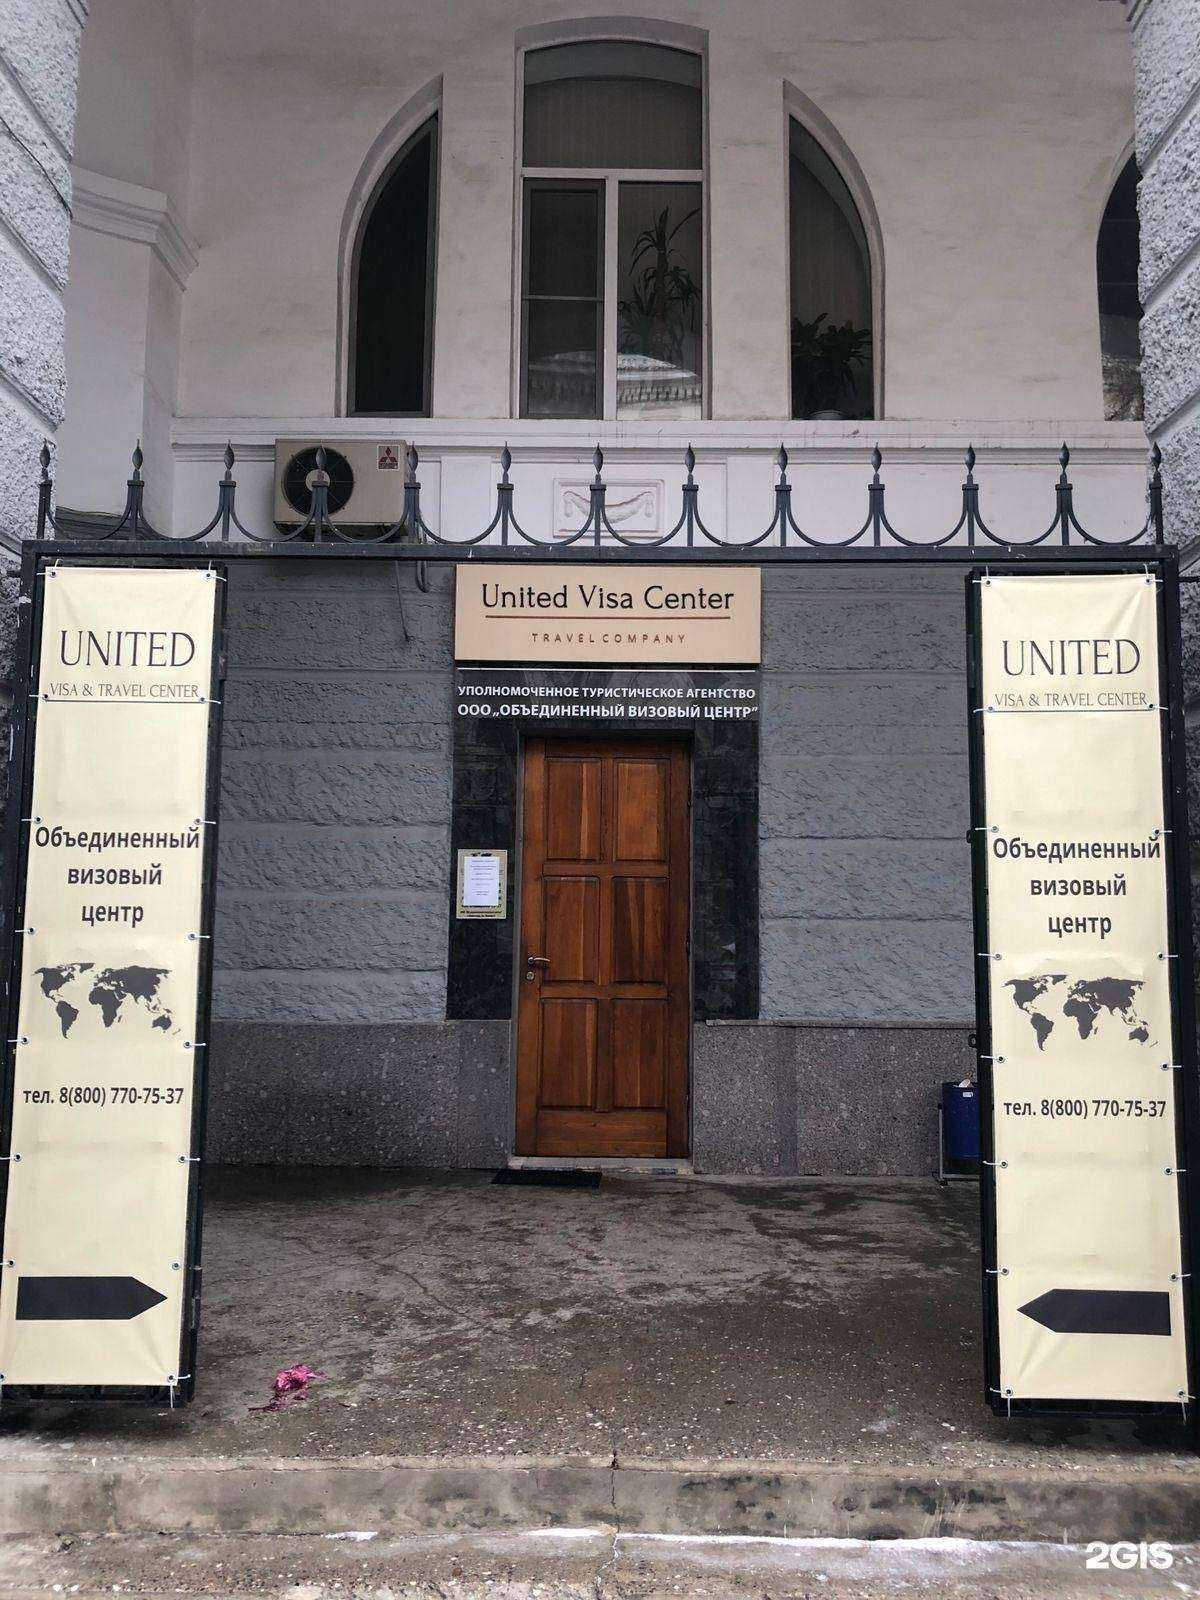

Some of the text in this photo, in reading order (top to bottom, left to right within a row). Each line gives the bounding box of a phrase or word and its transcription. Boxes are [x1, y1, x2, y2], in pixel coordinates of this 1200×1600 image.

[482, 583, 734, 610] United Visa Center
[59, 630, 196, 667] UNITED
[1002, 638, 1141, 676] UNITED
[49, 682, 199, 699] VISA & TRAVEL CENTER
[457, 685, 756, 699] УПОЛНОМОЧЕННОЕ ТУРИСТИЧЕСКОЕ АГЕНТСТВО
[994, 692, 1147, 707] VISA & TRAVEL CENTER
[628, 704, 700, 718] ВИЗОВЫЙ
[34, 825, 200, 853] Объединенный
[992, 836, 1161, 864] Объединенный
[67, 865, 162, 885] визовый
[1030, 873, 1127, 896] визовый
[81, 905, 144, 928] центр
[1048, 916, 1112, 940] центр
[22, 1087, 184, 1106] тел. 8(800) 770-75-37
[1003, 1099, 1167, 1119] тел. 8(800) 770-75-37
